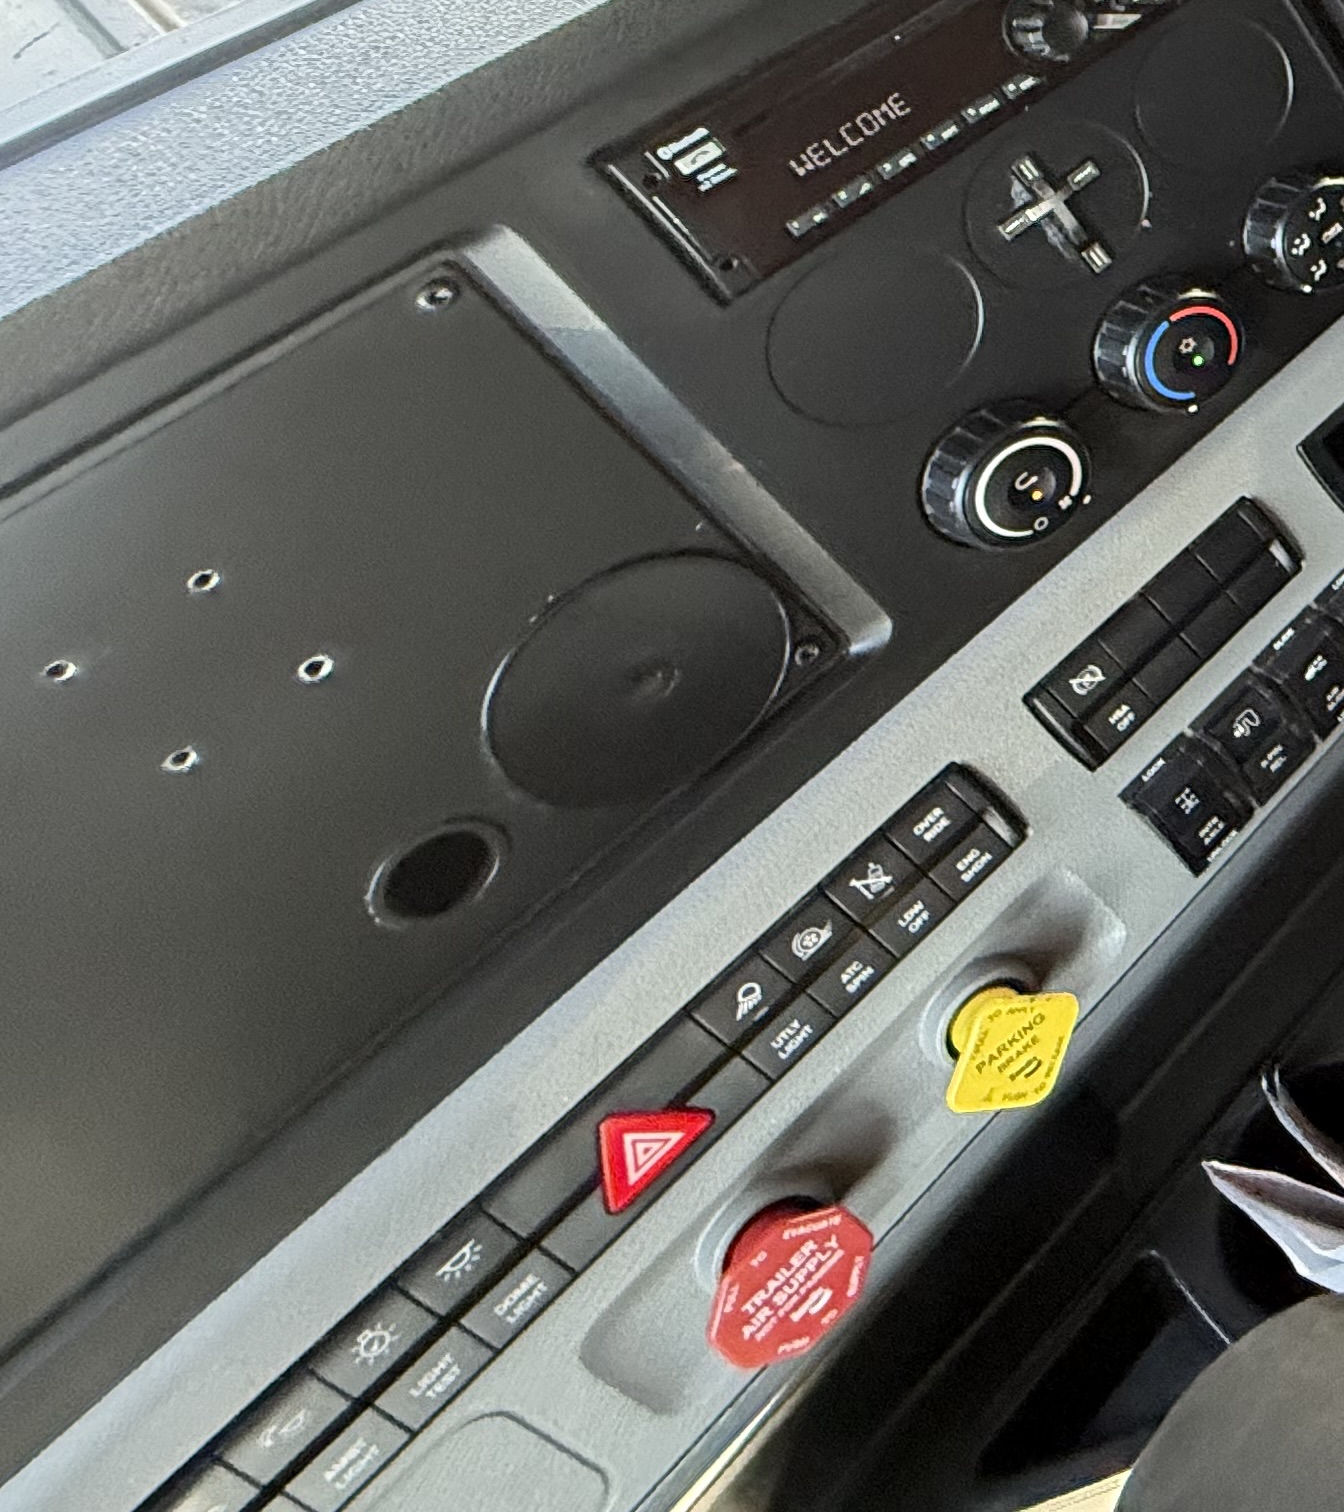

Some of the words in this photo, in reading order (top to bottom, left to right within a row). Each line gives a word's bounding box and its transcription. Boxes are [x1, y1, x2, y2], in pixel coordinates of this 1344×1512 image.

[789, 91, 912, 177] WELCOME
[1116, 712, 1136, 732] OFF
[913, 807, 945, 836] OVER
[923, 818, 951, 842] RIDE
[956, 848, 981, 871] ENG
[961, 852, 993, 882] SHDN
[898, 900, 925, 928] LDW
[908, 910, 930, 933] OFF
[840, 961, 864, 984] ATC
[845, 966, 875, 993] SPIN
[778, 1024, 813, 1060] LIGHT
[975, 1013, 1045, 1074] PARKING
[997, 1035, 1040, 1073] BRAKE
[741, 1240, 818, 1314] TRAILER
[742, 1306, 774, 1340] AIR
[772, 1234, 839, 1306] SUPPLY
[494, 1274, 541, 1317] DOME
[506, 1281, 548, 1324] LIGHT
[409, 1352, 455, 1398] LIGHT
[425, 1363, 461, 1399] TEST
[335, 1444, 380, 1490] LIGHT
